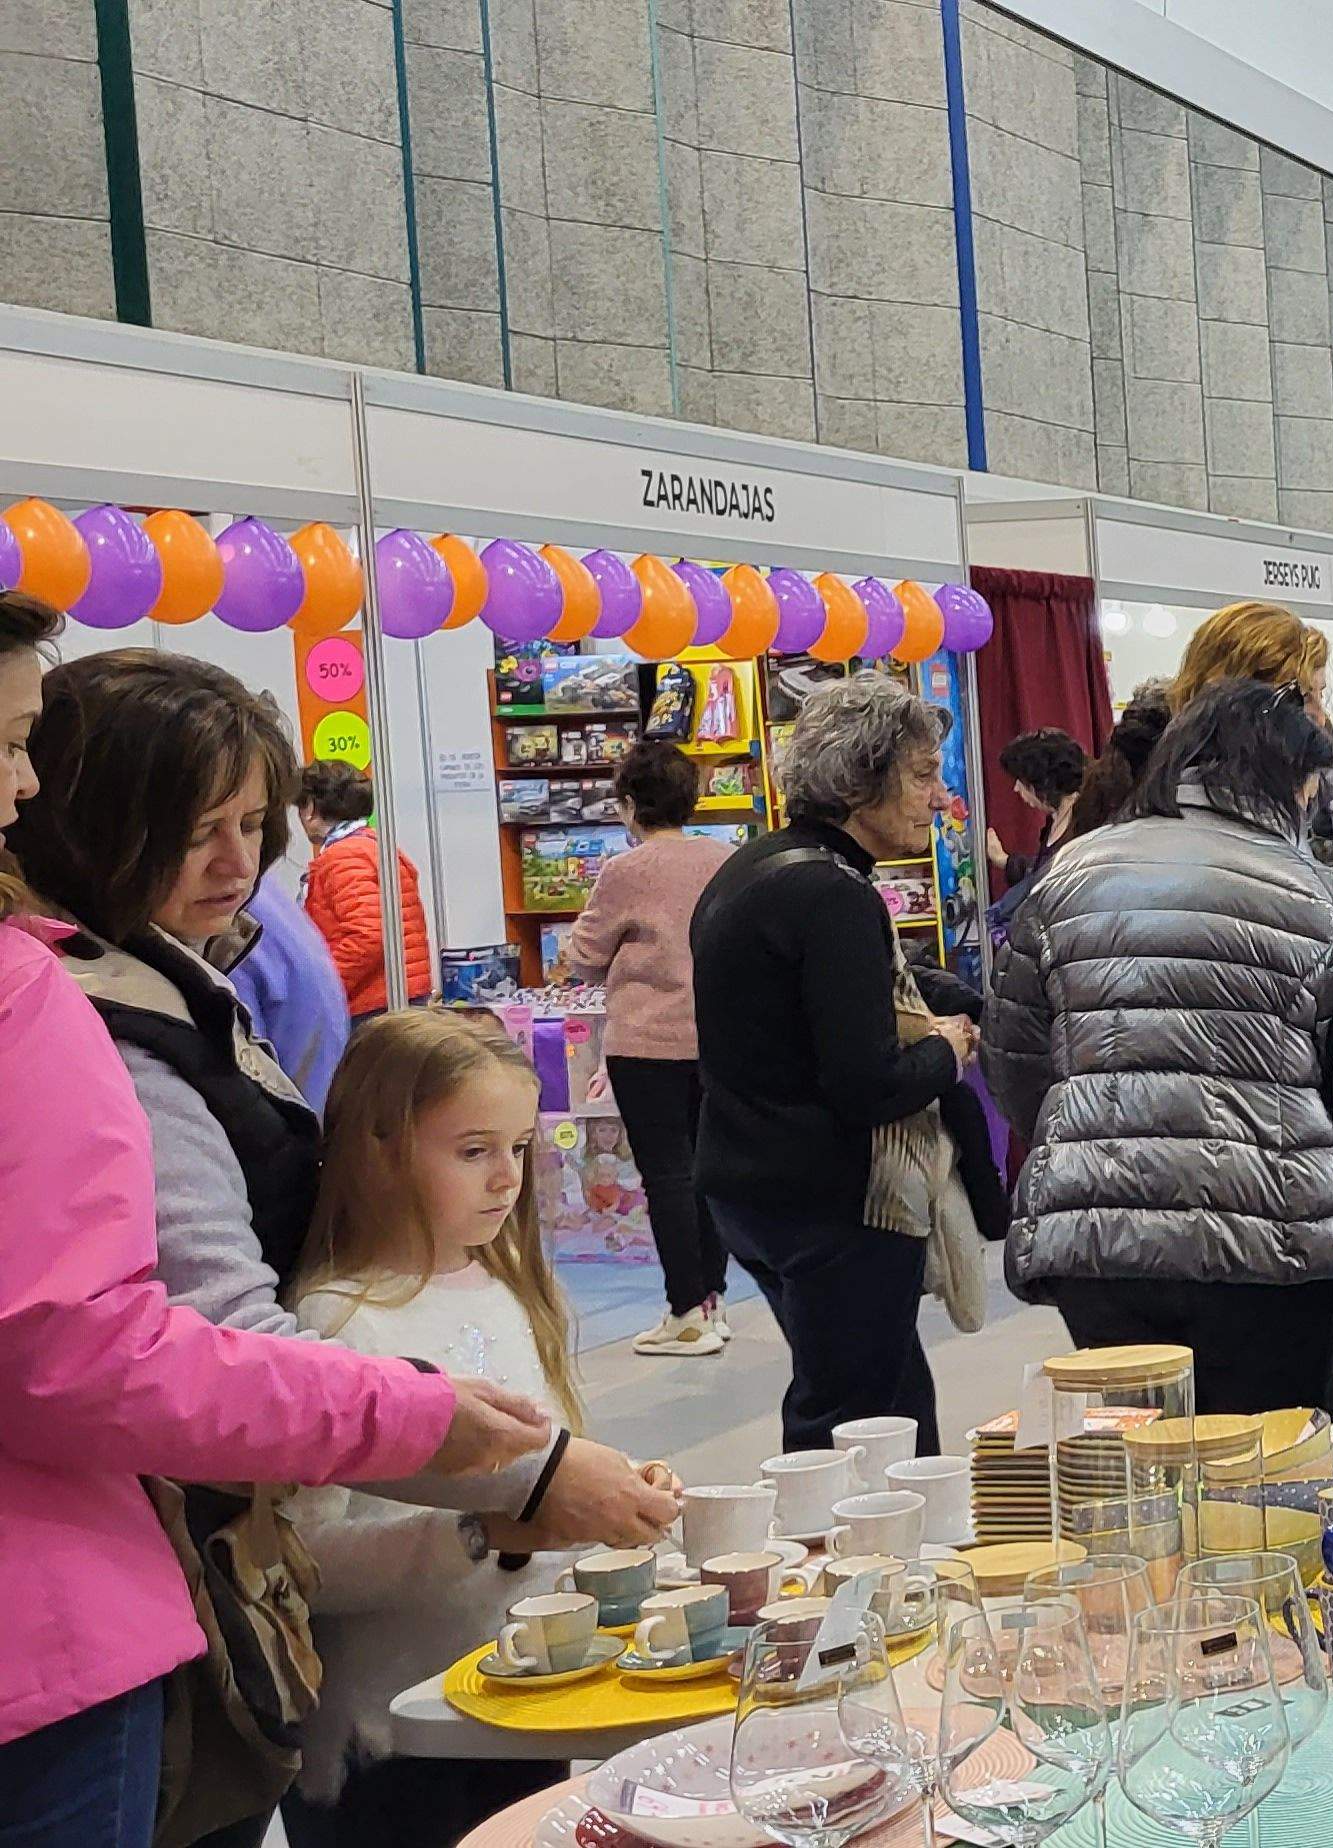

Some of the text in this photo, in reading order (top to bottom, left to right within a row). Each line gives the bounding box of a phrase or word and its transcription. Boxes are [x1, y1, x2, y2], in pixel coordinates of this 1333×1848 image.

[641, 469, 775, 522] ZARANDAJAS
[1263, 560, 1321, 590] JERSEYS PUIG
[319, 662, 353, 680] 50%
[327, 735, 361, 753] 30%
